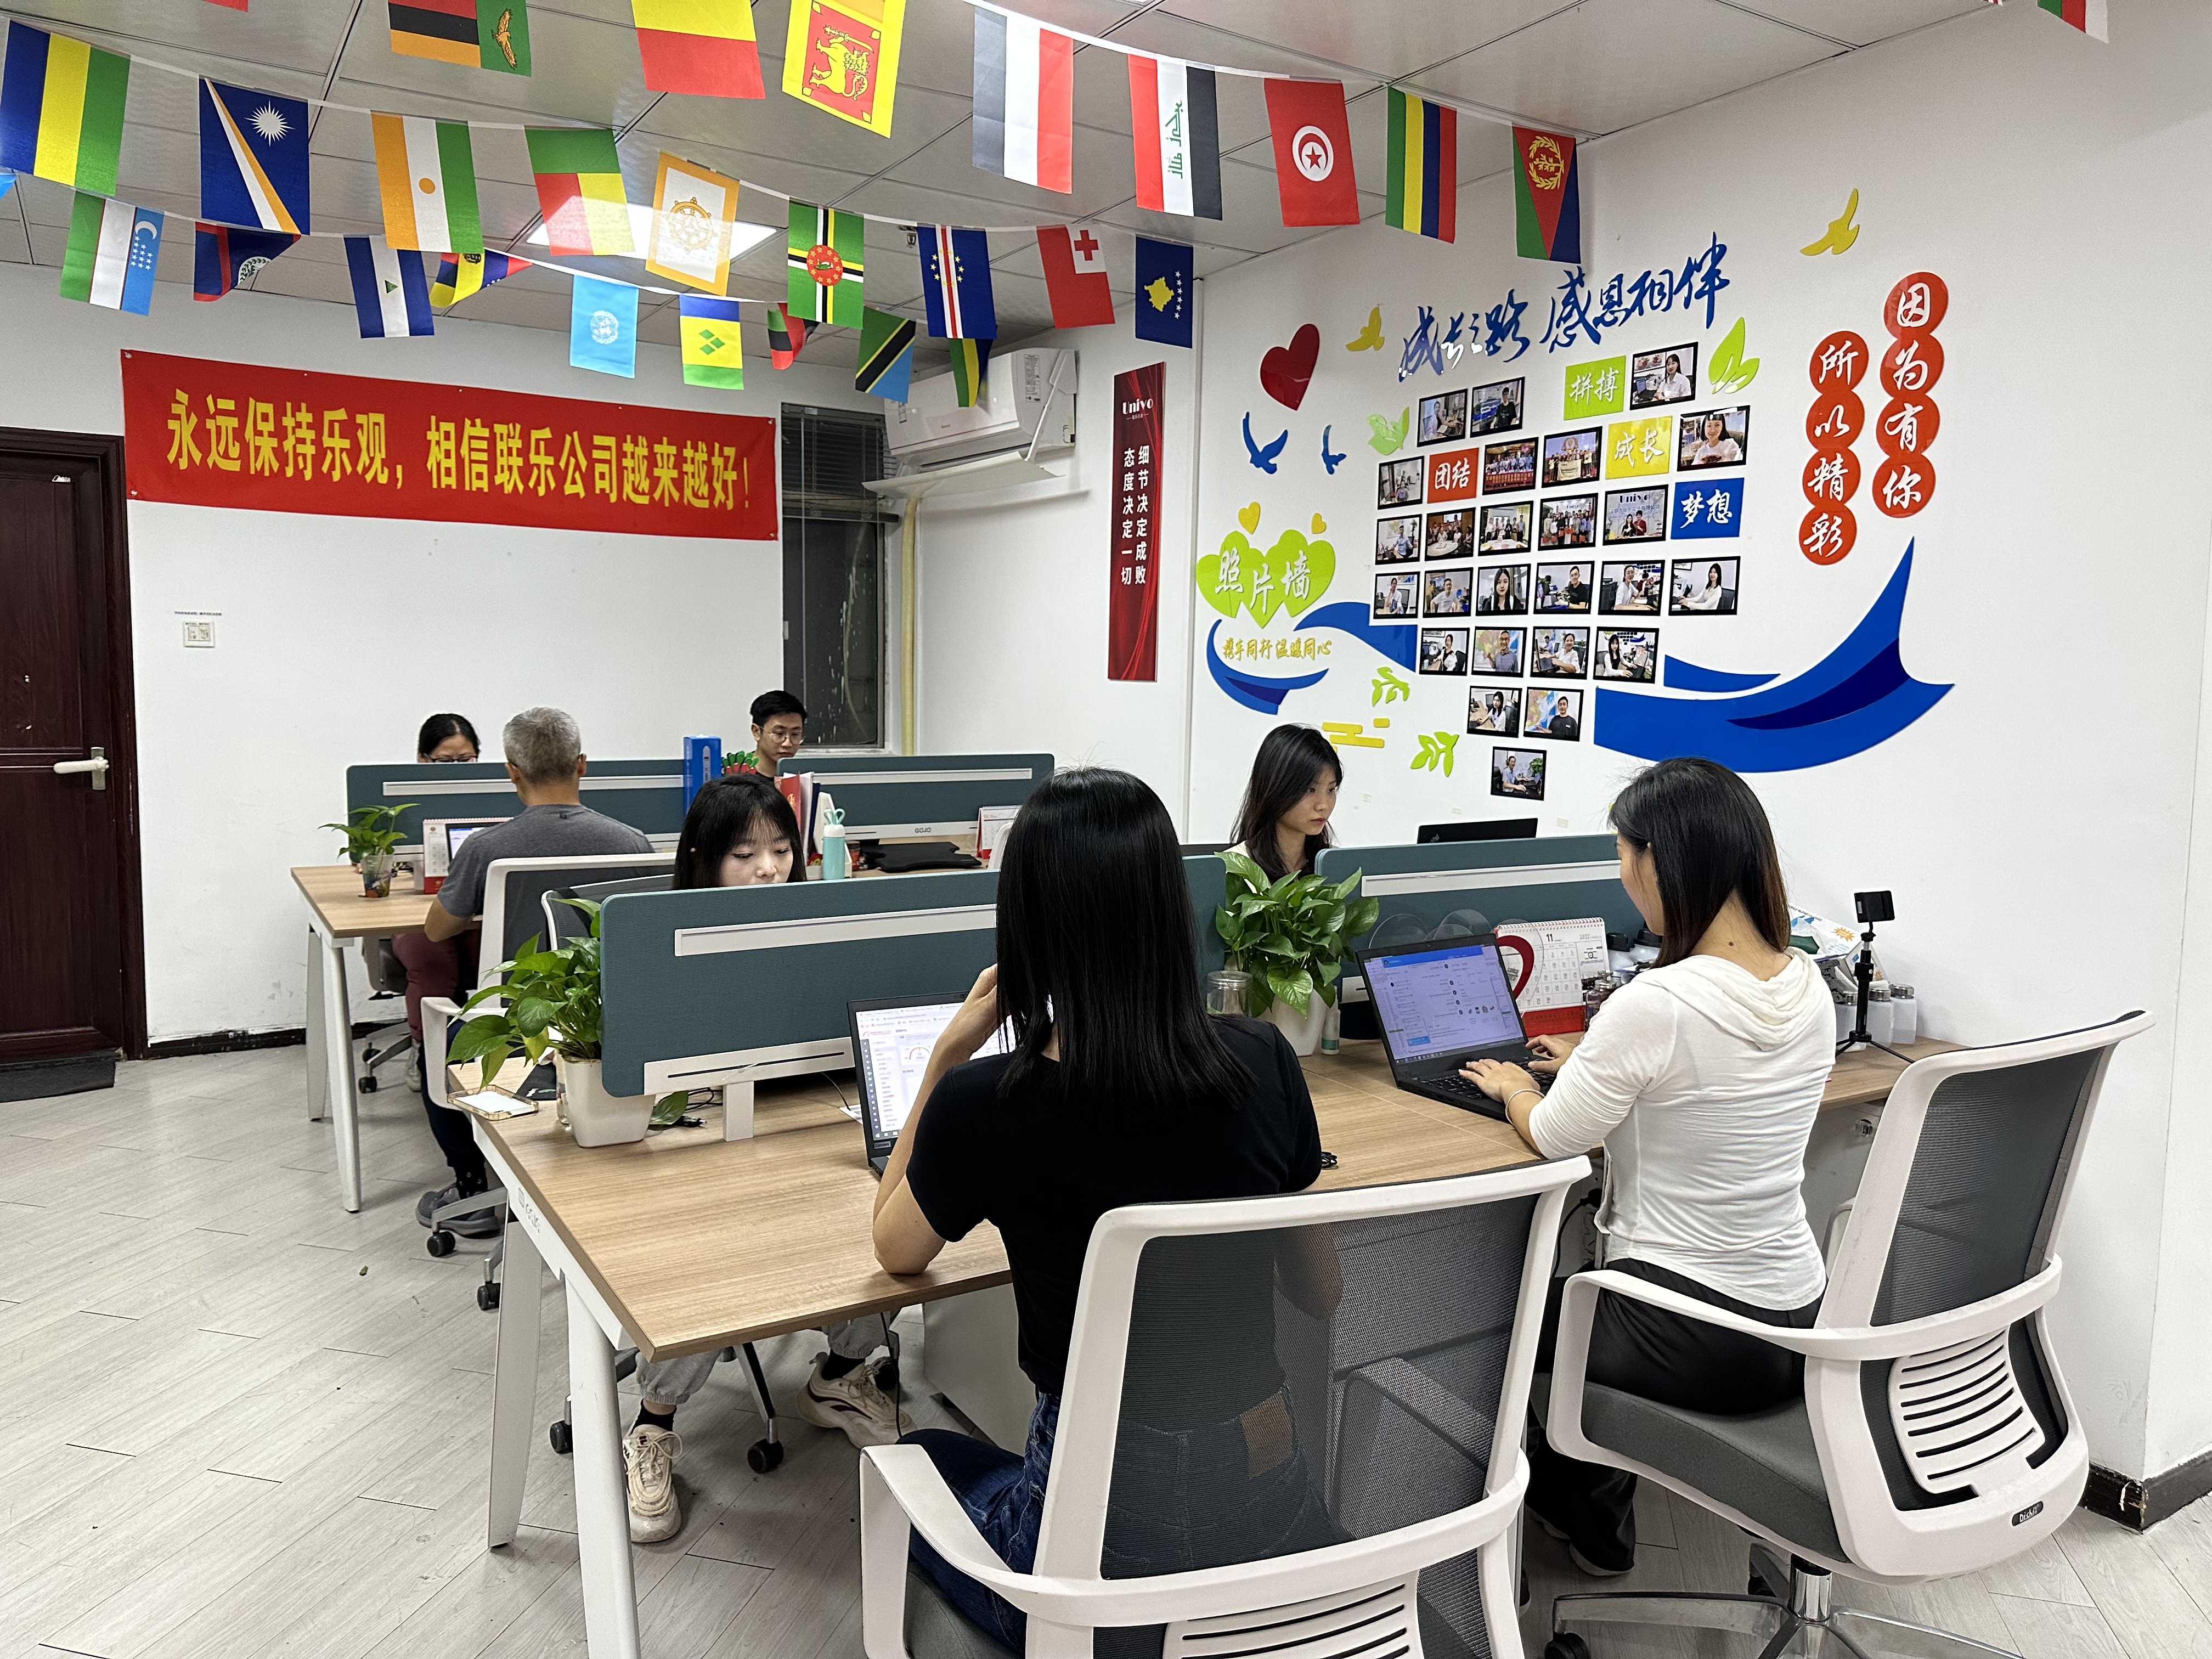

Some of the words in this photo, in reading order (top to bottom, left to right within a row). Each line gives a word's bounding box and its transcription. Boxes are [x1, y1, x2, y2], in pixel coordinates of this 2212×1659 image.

[1540, 232, 1730, 353] 感恩相伴
[1122, 398, 1154, 415] Univo
[1570, 367, 1618, 406] 拼搏
[1882, 283, 1931, 510] 因为有你
[1434, 458, 1471, 491] 团结
[1614, 429, 1664, 468] 成长
[1803, 340, 1859, 558] 所以精彩
[1121, 448, 1135, 586] 态度决定一切
[1135, 445, 1150, 585] 细节决定成败
[1680, 489, 1733, 529] 梦想
[1215, 547, 1312, 615] 照片墙
[1546, 933, 1553, 942] 11
